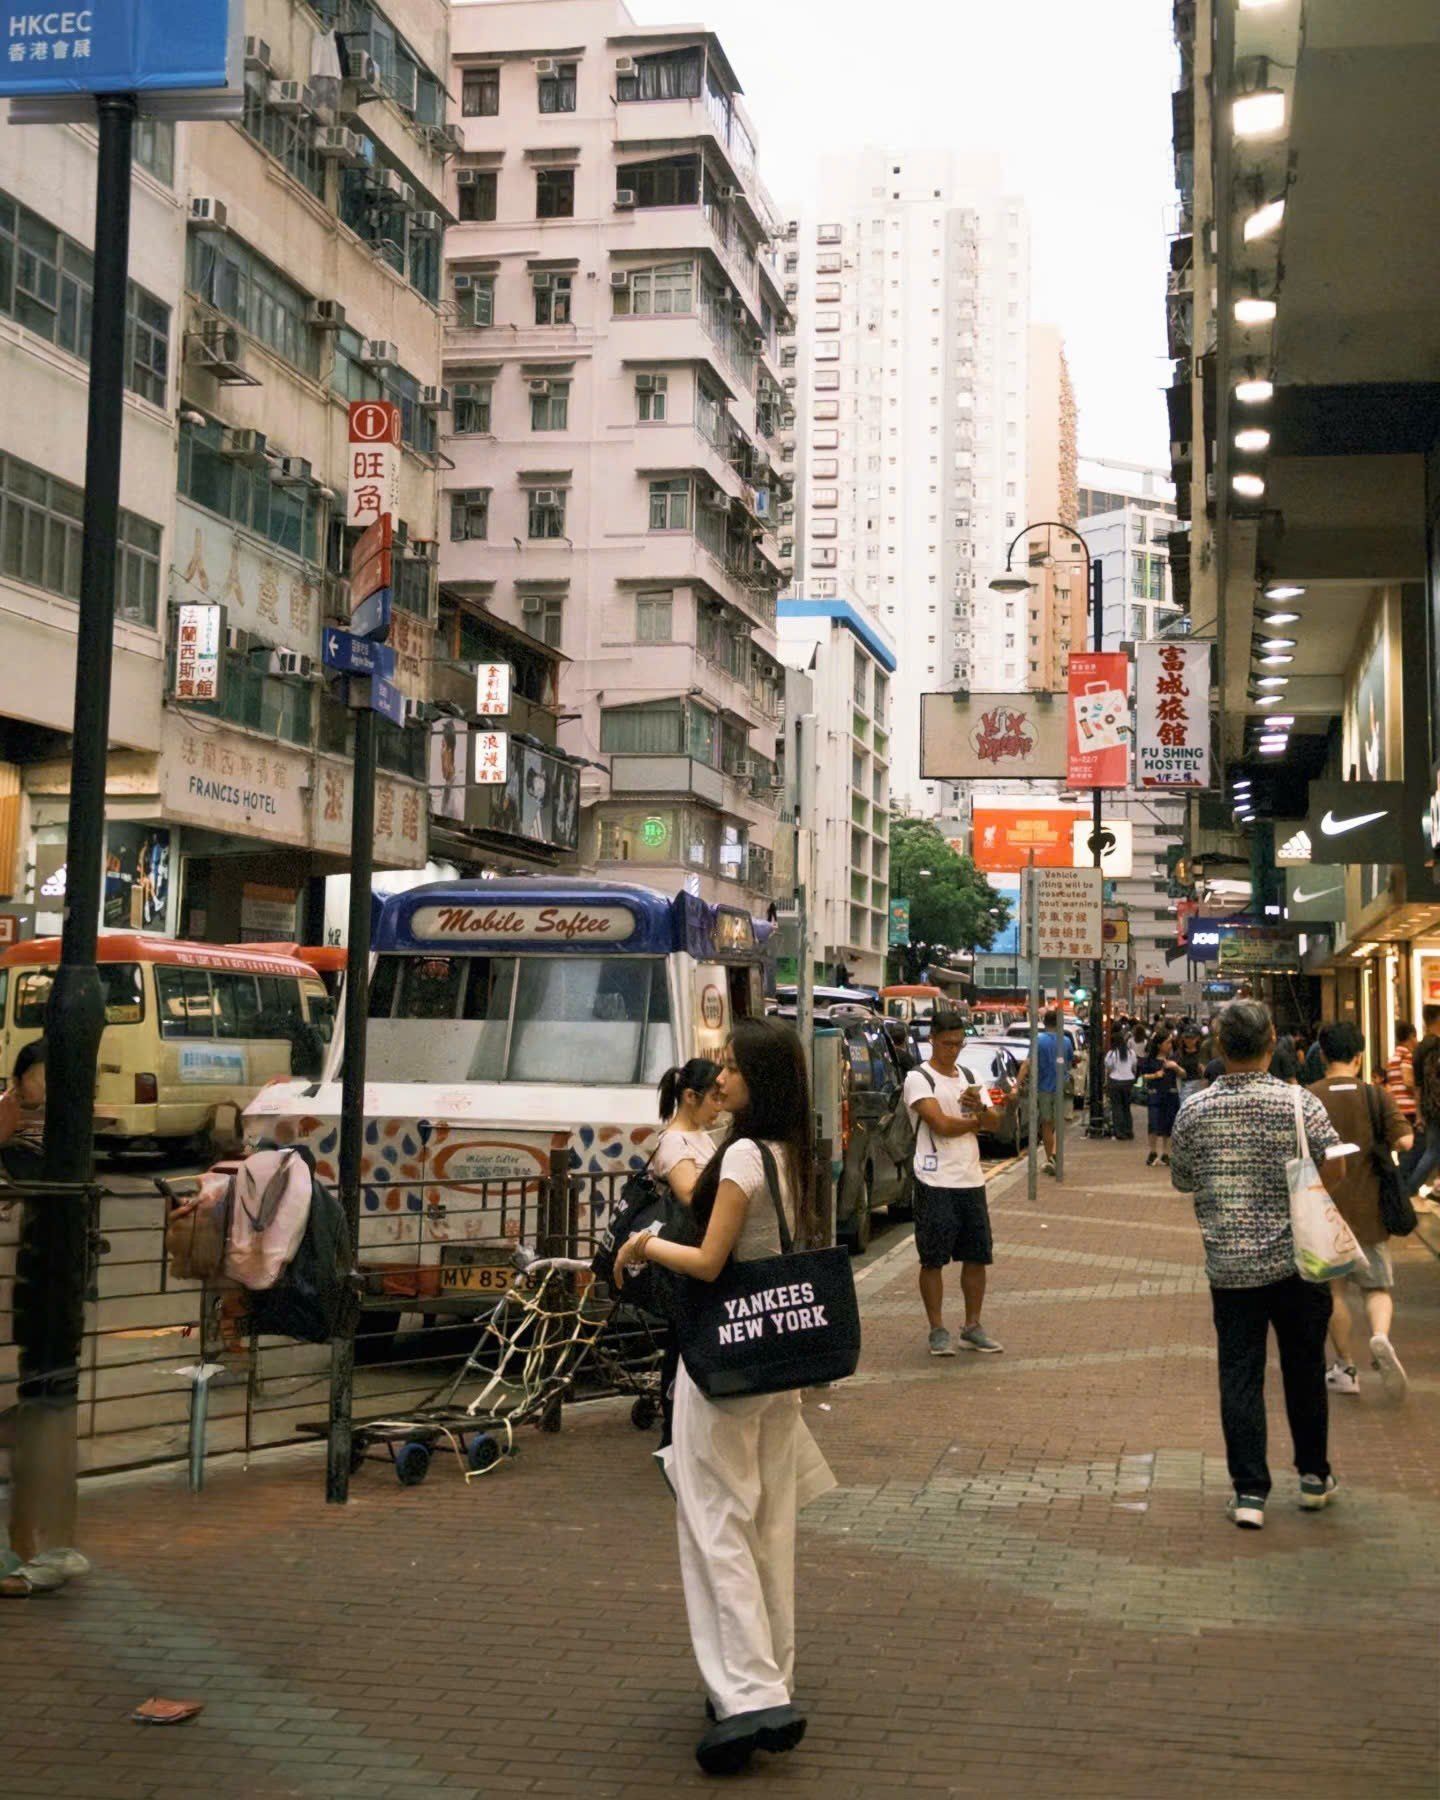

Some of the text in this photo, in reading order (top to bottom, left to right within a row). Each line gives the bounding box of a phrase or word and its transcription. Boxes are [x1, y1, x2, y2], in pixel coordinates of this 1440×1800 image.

[9, 10, 92, 37] HKCEC
[8, 39, 91, 61] 香港會展
[353, 452, 385, 518] 旺角
[179, 607, 198, 679] 法蘭西斯
[1156, 645, 1190, 747] 富城旅館
[1141, 747, 1204, 759] FU SHING
[1144, 759, 1201, 770] HOSTEL
[189, 776, 276, 815] FRANCIS HOTEL
[1045, 871, 1078, 879] Vehicle
[1065, 881, 1080, 889] will
[1083, 881, 1094, 889] be
[1062, 900, 1099, 909] warning
[437, 908, 611, 939] Mobile Softee
[1113, 944, 1120, 953] 7
[1113, 959, 1126, 969] 12
[444, 1267, 537, 1290] MV 858
[723, 1282, 815, 1320] YANKEES
[718, 1304, 829, 1345] NEW YORK
